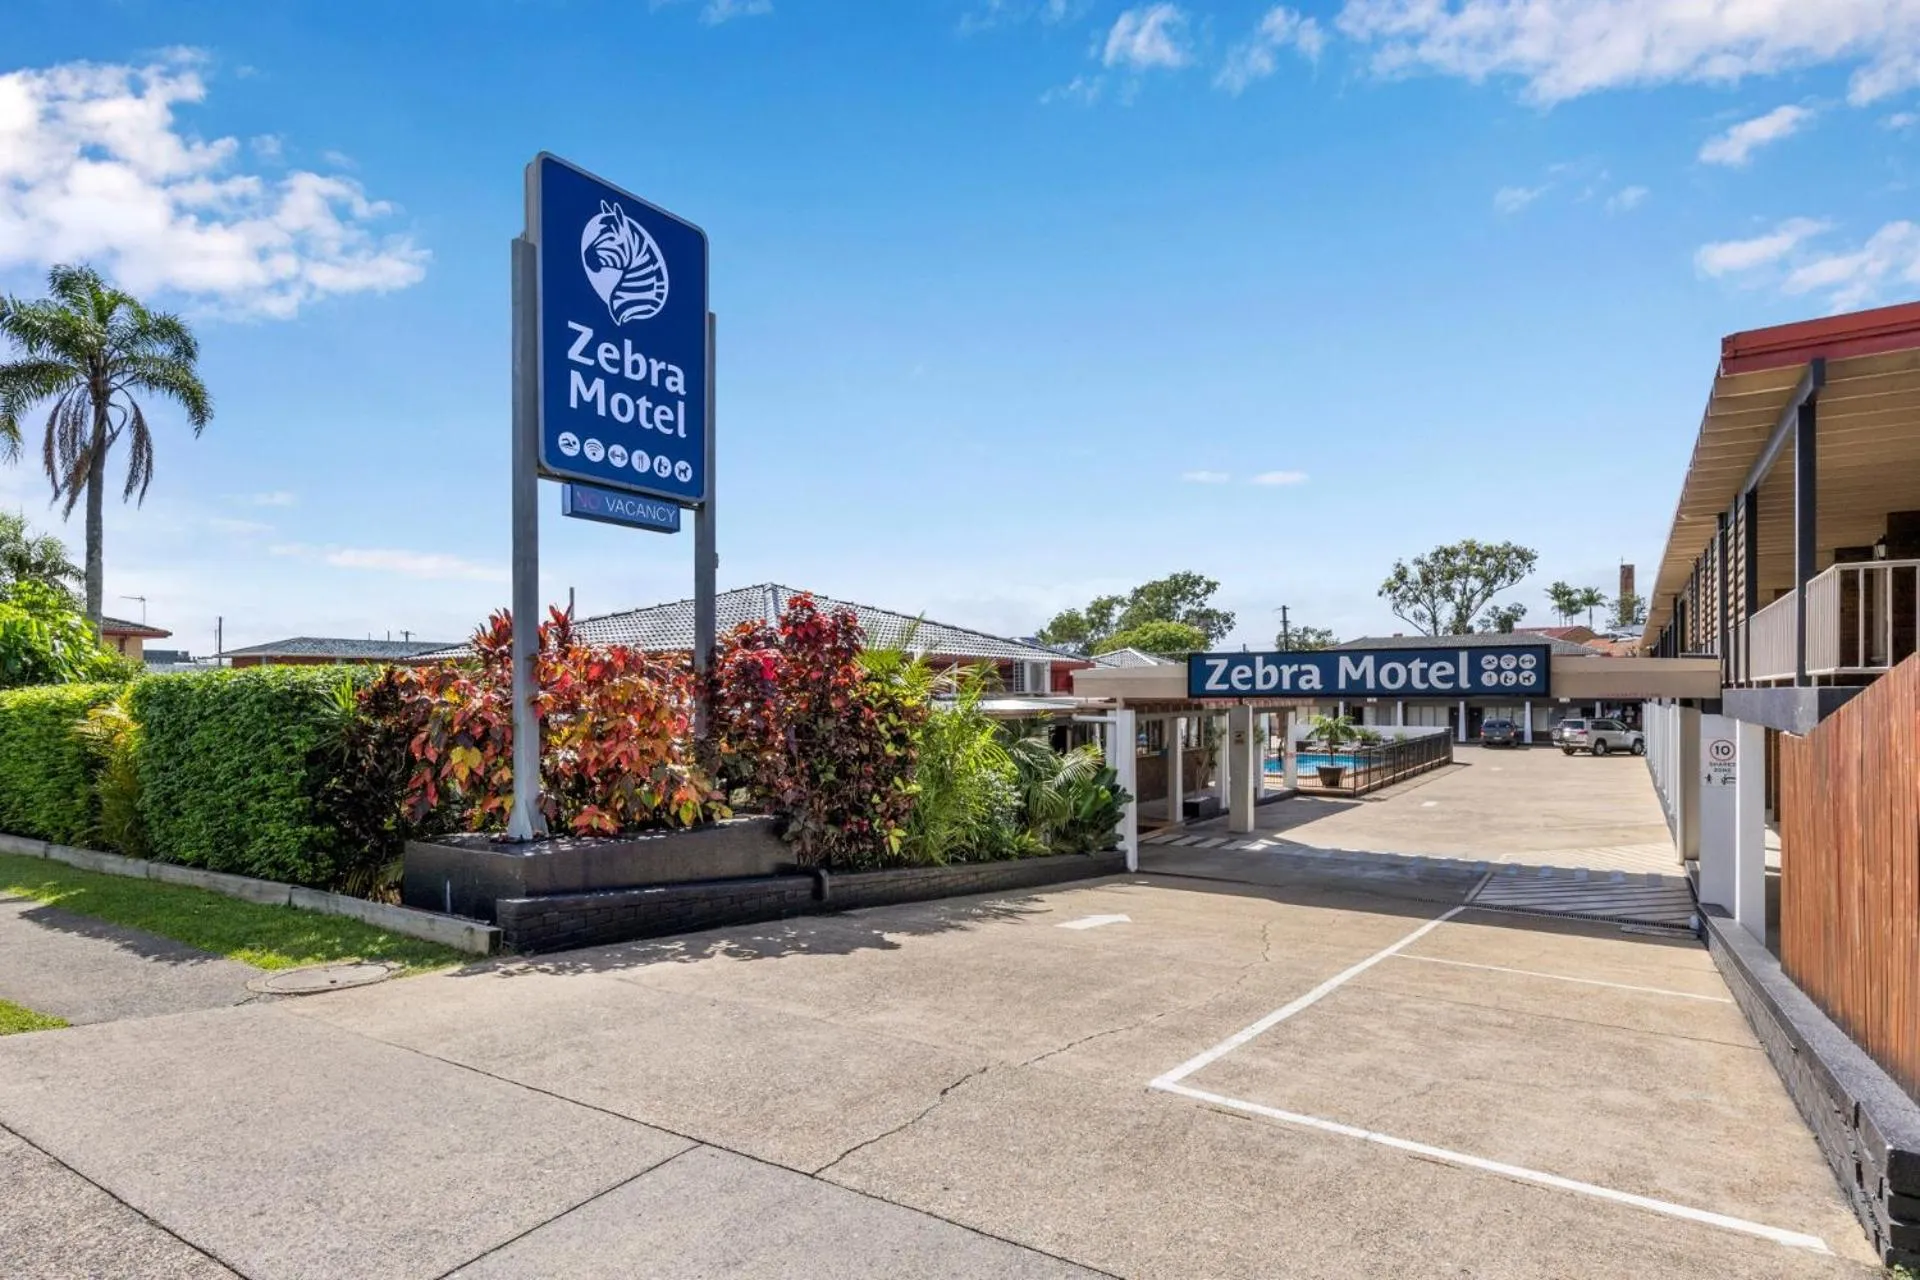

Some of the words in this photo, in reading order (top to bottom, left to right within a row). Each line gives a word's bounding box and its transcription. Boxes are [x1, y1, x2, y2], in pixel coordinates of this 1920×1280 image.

[567, 321, 687, 396] Zebra
[570, 369, 687, 438] Motel
[605, 496, 676, 523] VACANCY
[1205, 656, 1323, 691] Zebra
[1338, 651, 1471, 690] Motel
[1715, 745, 1731, 756] 10
